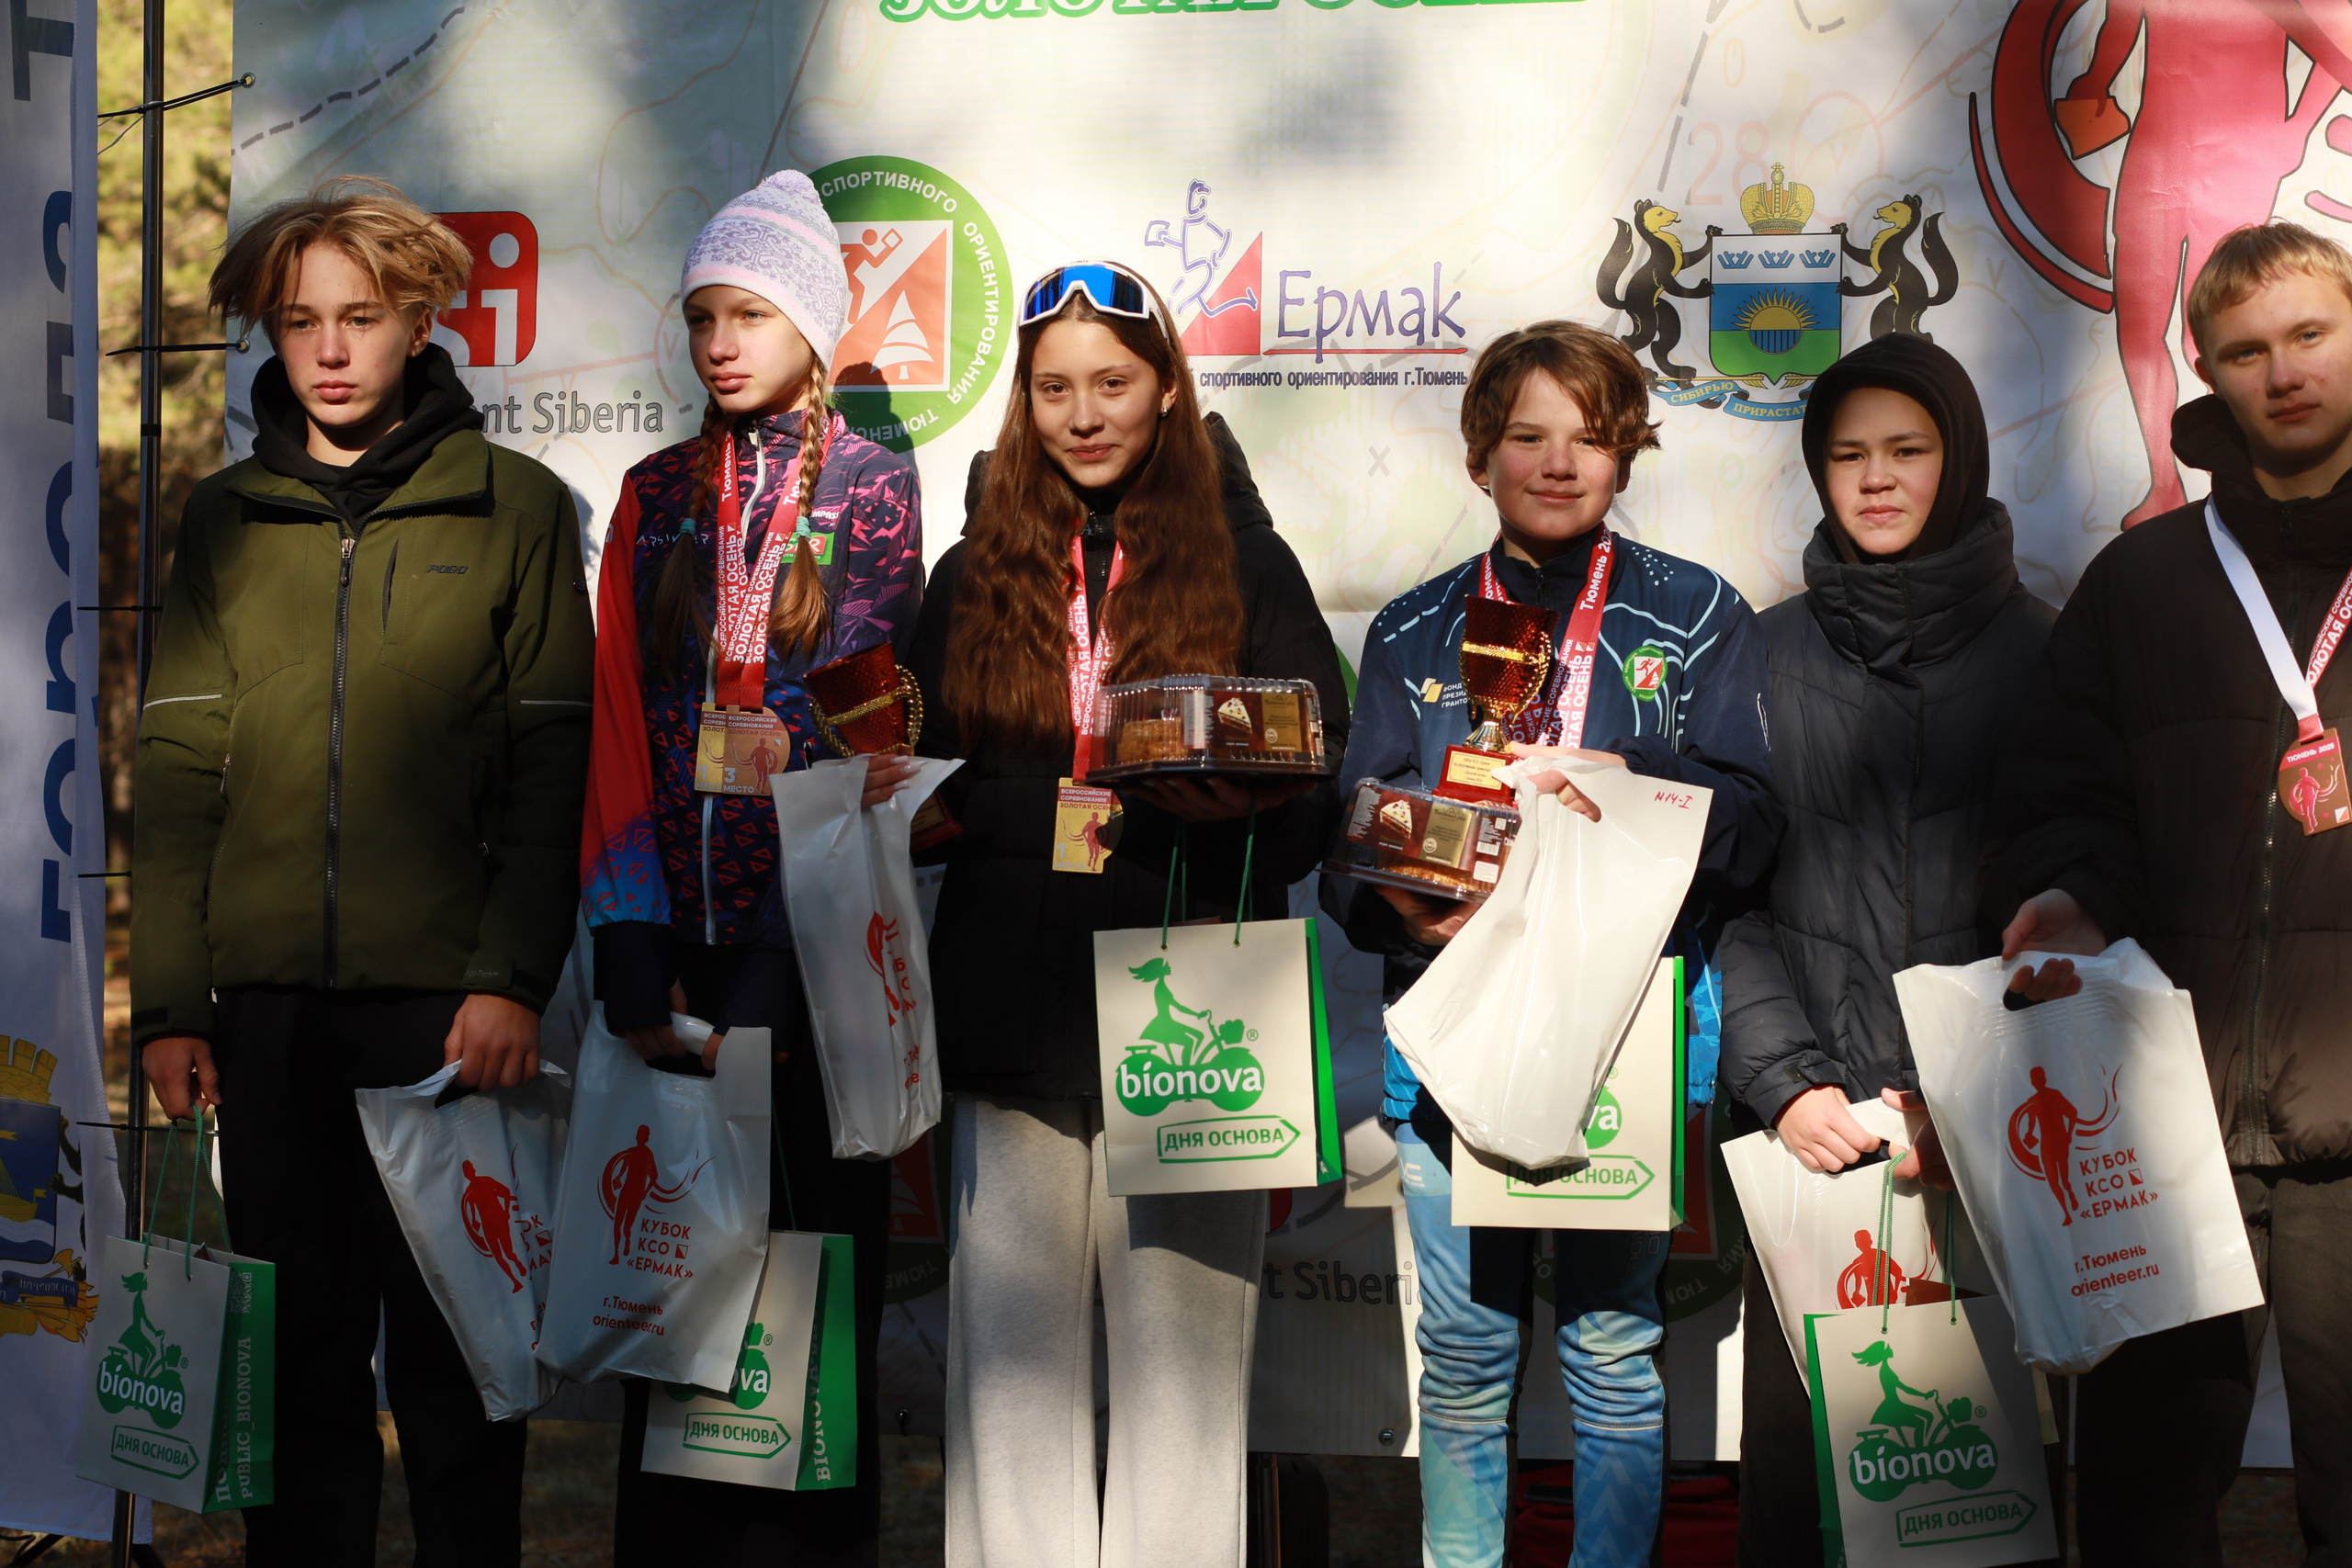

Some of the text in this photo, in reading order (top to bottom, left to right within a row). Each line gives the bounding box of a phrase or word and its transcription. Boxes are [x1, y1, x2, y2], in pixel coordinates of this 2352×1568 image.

[820, 171, 957, 214] СПОРТИВНОГО
[946, 220, 1000, 406] ОРИЕНТИРОВАНИЯ
[1277, 261, 1466, 365] Ермак
[1199, 367, 1468, 390] спортивного ориентирования г.Тюмень
[1669, 380, 1735, 405] СИБИРЬЮ
[532, 389, 663, 434] Siberia
[721, 443, 732, 502] Тюмень
[727, 536, 739, 582] ОСЕНЬ
[748, 532, 775, 592] СОРЕВНОВАНИЯ
[1579, 555, 1608, 611] Тюмень
[733, 594, 762, 664] ЗОЛОТАЯ
[755, 544, 780, 592] ОСЕНЬ
[1075, 594, 1089, 647] ОСЕНЬ
[2308, 619, 2345, 685] ОЛОТАЯ
[1442, 682, 1463, 693] ФОНД
[1547, 638, 1574, 705] СОРЕВНОВАНИЯ
[1559, 655, 1582, 708] ОСЕНЬ
[1573, 655, 1593, 706] ОСЕНЬ
[1081, 658, 1101, 736] ВСЕРОССИЙСКИЕ
[1441, 697, 1468, 708] ГРАНТО
[728, 715, 778, 723] ВСЕРОССИЙСКИЕ
[2286, 742, 2335, 764] ТЮМЕНЬ 2025
[723, 784, 755, 794] МЕСТО
[724, 767, 736, 784] 3
[1061, 788, 1112, 796] ВСЕРОССИЙСКИЕ
[1056, 842, 1066, 859] 1
[1120, 1060, 1263, 1099] bionova
[1164, 1128, 1284, 1152] ДНЯ ОСНОВА
[1513, 1165, 1638, 1186] ДНЯ ОСНОВА
[2079, 1148, 2139, 1177] КУБОК
[2085, 1174, 2124, 1196] КСО
[2080, 1190, 2159, 1221] «ЕРМАК»
[640, 1217, 692, 1240] КУБОК
[638, 1237, 670, 1255] КСО
[2074, 1242, 2147, 1274] г.Тюмень
[627, 1258, 694, 1279] «ЕРМАК»
[1294, 1260, 1419, 1305] Siberi
[2071, 1263, 2160, 1297] orienteer.ru
[603, 1295, 663, 1316] г.Тюмень
[593, 1314, 664, 1337] orienteer.ru
[99, 1361, 184, 1416] bionova
[237, 1337, 254, 1499] PUBLIC_BIONOVA
[689, 1419, 779, 1447] ДНЯ ОСНОВА
[114, 1430, 189, 1468] ДНЯ ОСНОВА
[1853, 1440, 1996, 1484] bionova
[1903, 1501, 2022, 1538] ДНЯ ОСНОВА
